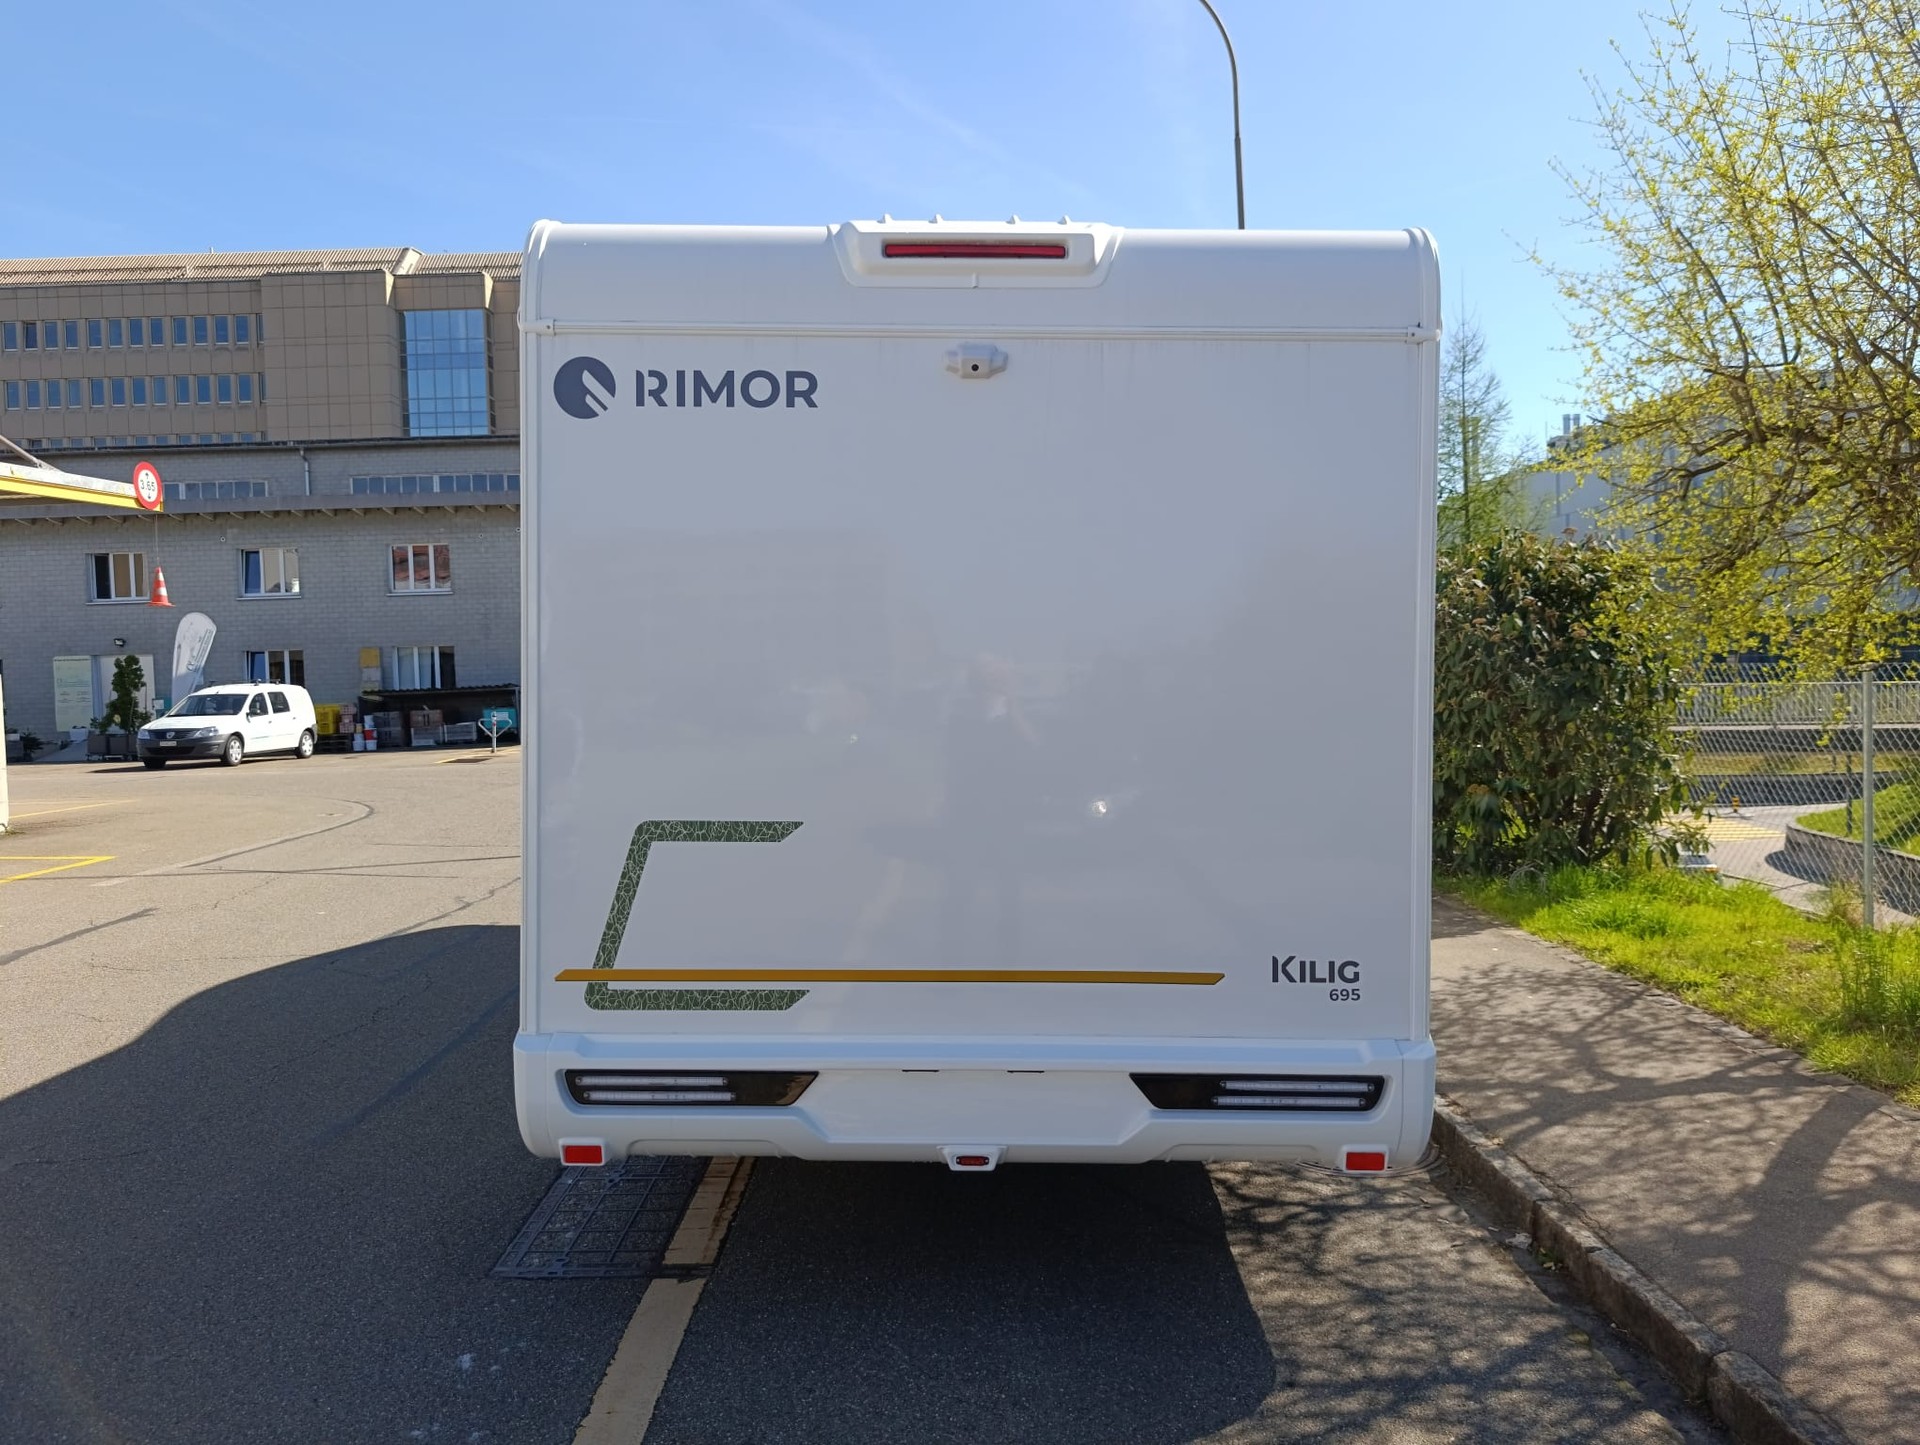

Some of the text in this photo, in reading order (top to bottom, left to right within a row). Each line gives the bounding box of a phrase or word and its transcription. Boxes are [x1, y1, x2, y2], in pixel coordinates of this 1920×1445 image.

[635, 369, 818, 408] RIMOR
[1271, 955, 1360, 984] KILIG
[1329, 988, 1361, 1001] 695
